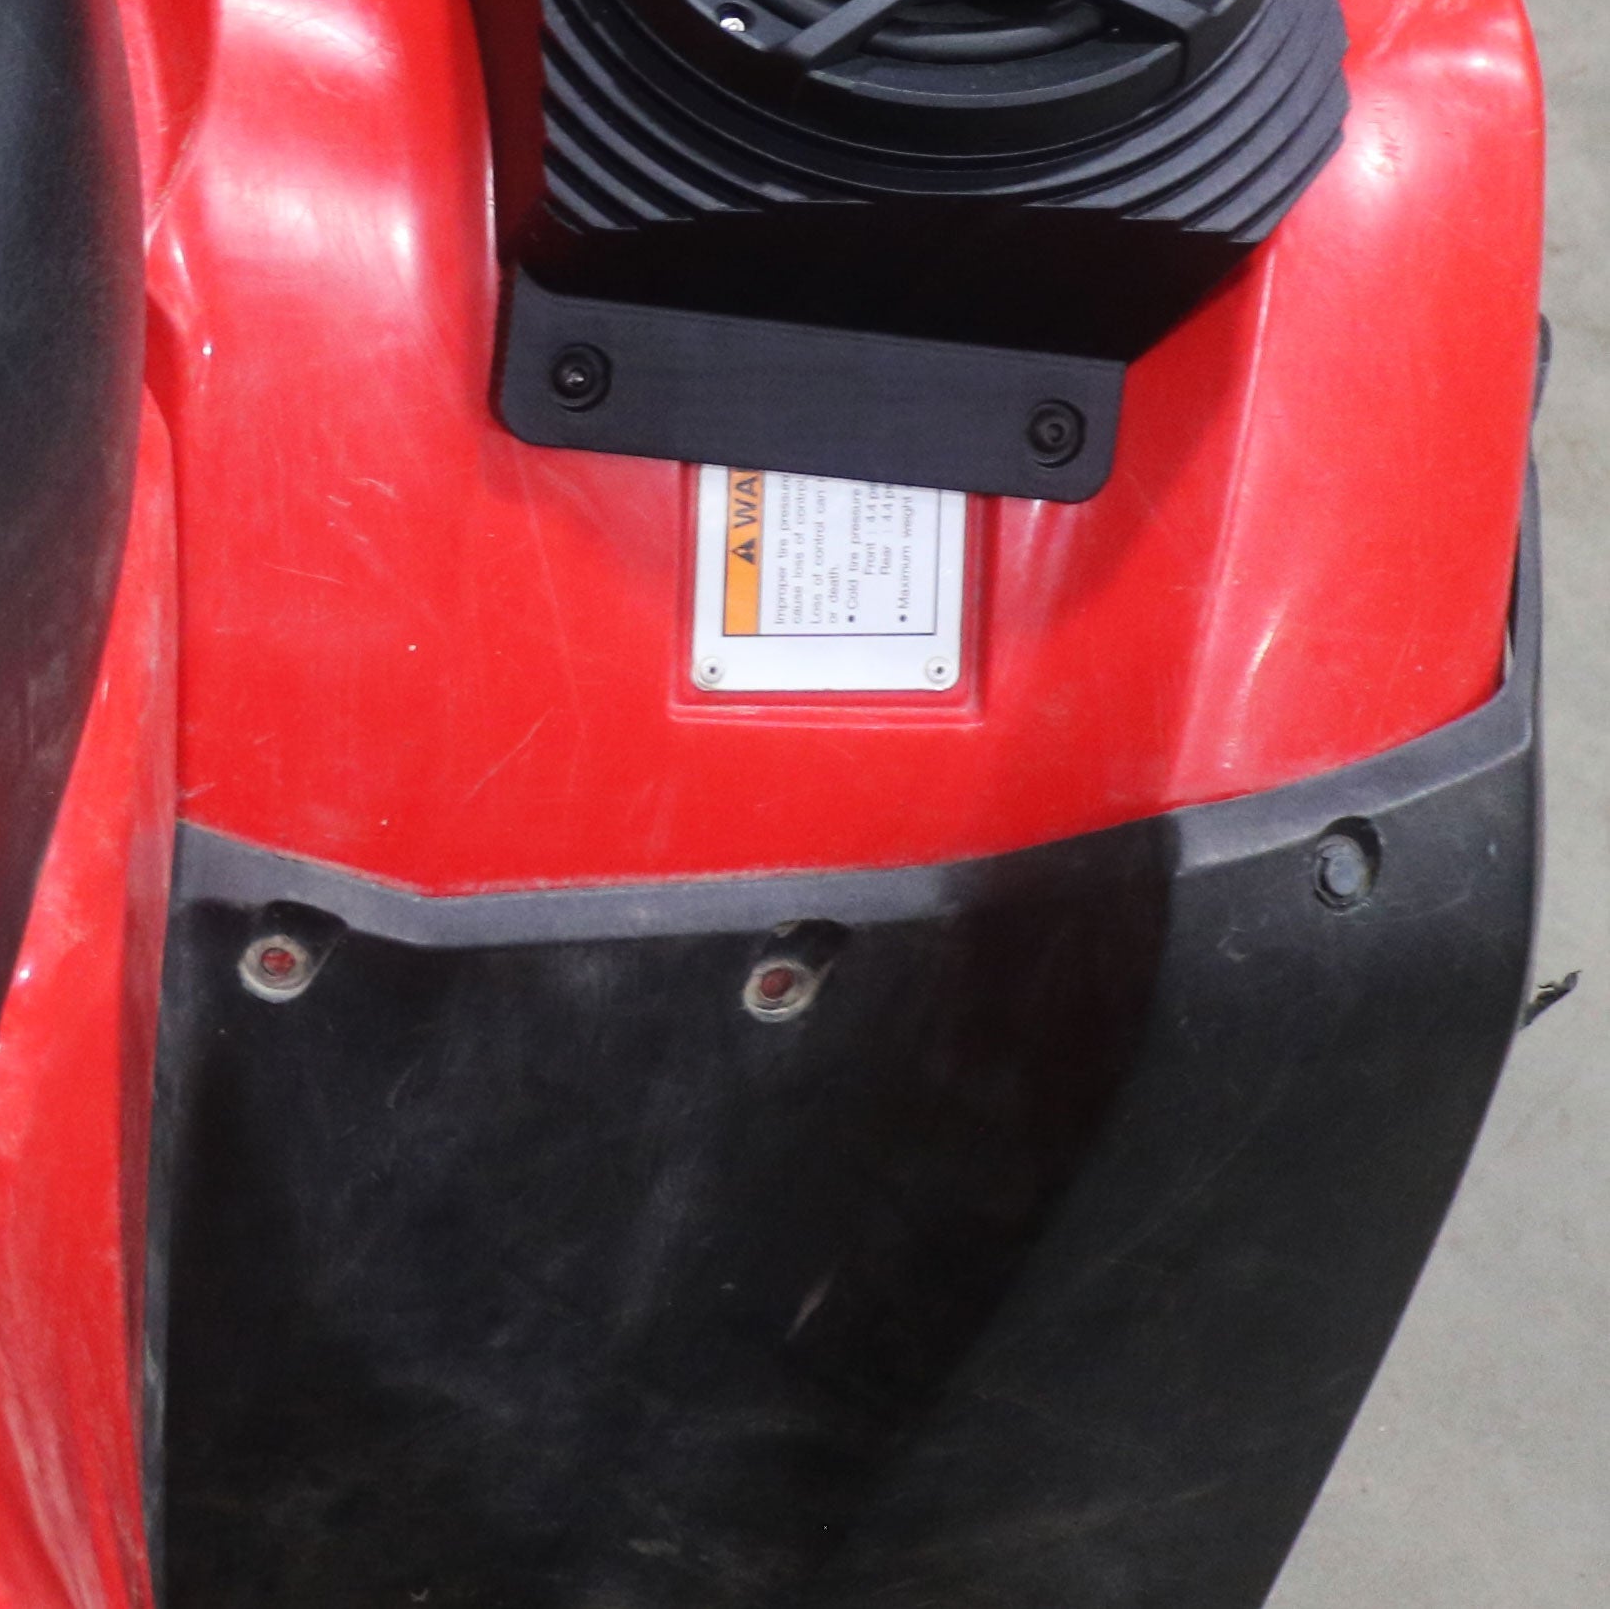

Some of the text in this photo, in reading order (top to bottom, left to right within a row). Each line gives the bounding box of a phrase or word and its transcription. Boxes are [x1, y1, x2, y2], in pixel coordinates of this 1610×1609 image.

[732, 469, 758, 529] WA
[816, 490, 826, 514] can
[777, 539, 789, 558] tire
[794, 531, 806, 544] of
[814, 521, 825, 566] control
[847, 488, 862, 610] Cold tire pressure
[898, 495, 915, 609] Maximum weight
[794, 552, 805, 578] loss
[864, 542, 876, 575] Front
[880, 545, 891, 575] Rear
[812, 573, 823, 586] of
[774, 566, 790, 625] Improper
[794, 585, 803, 625] cause
[811, 593, 822, 624] Loss
[828, 611, 838, 623] or
